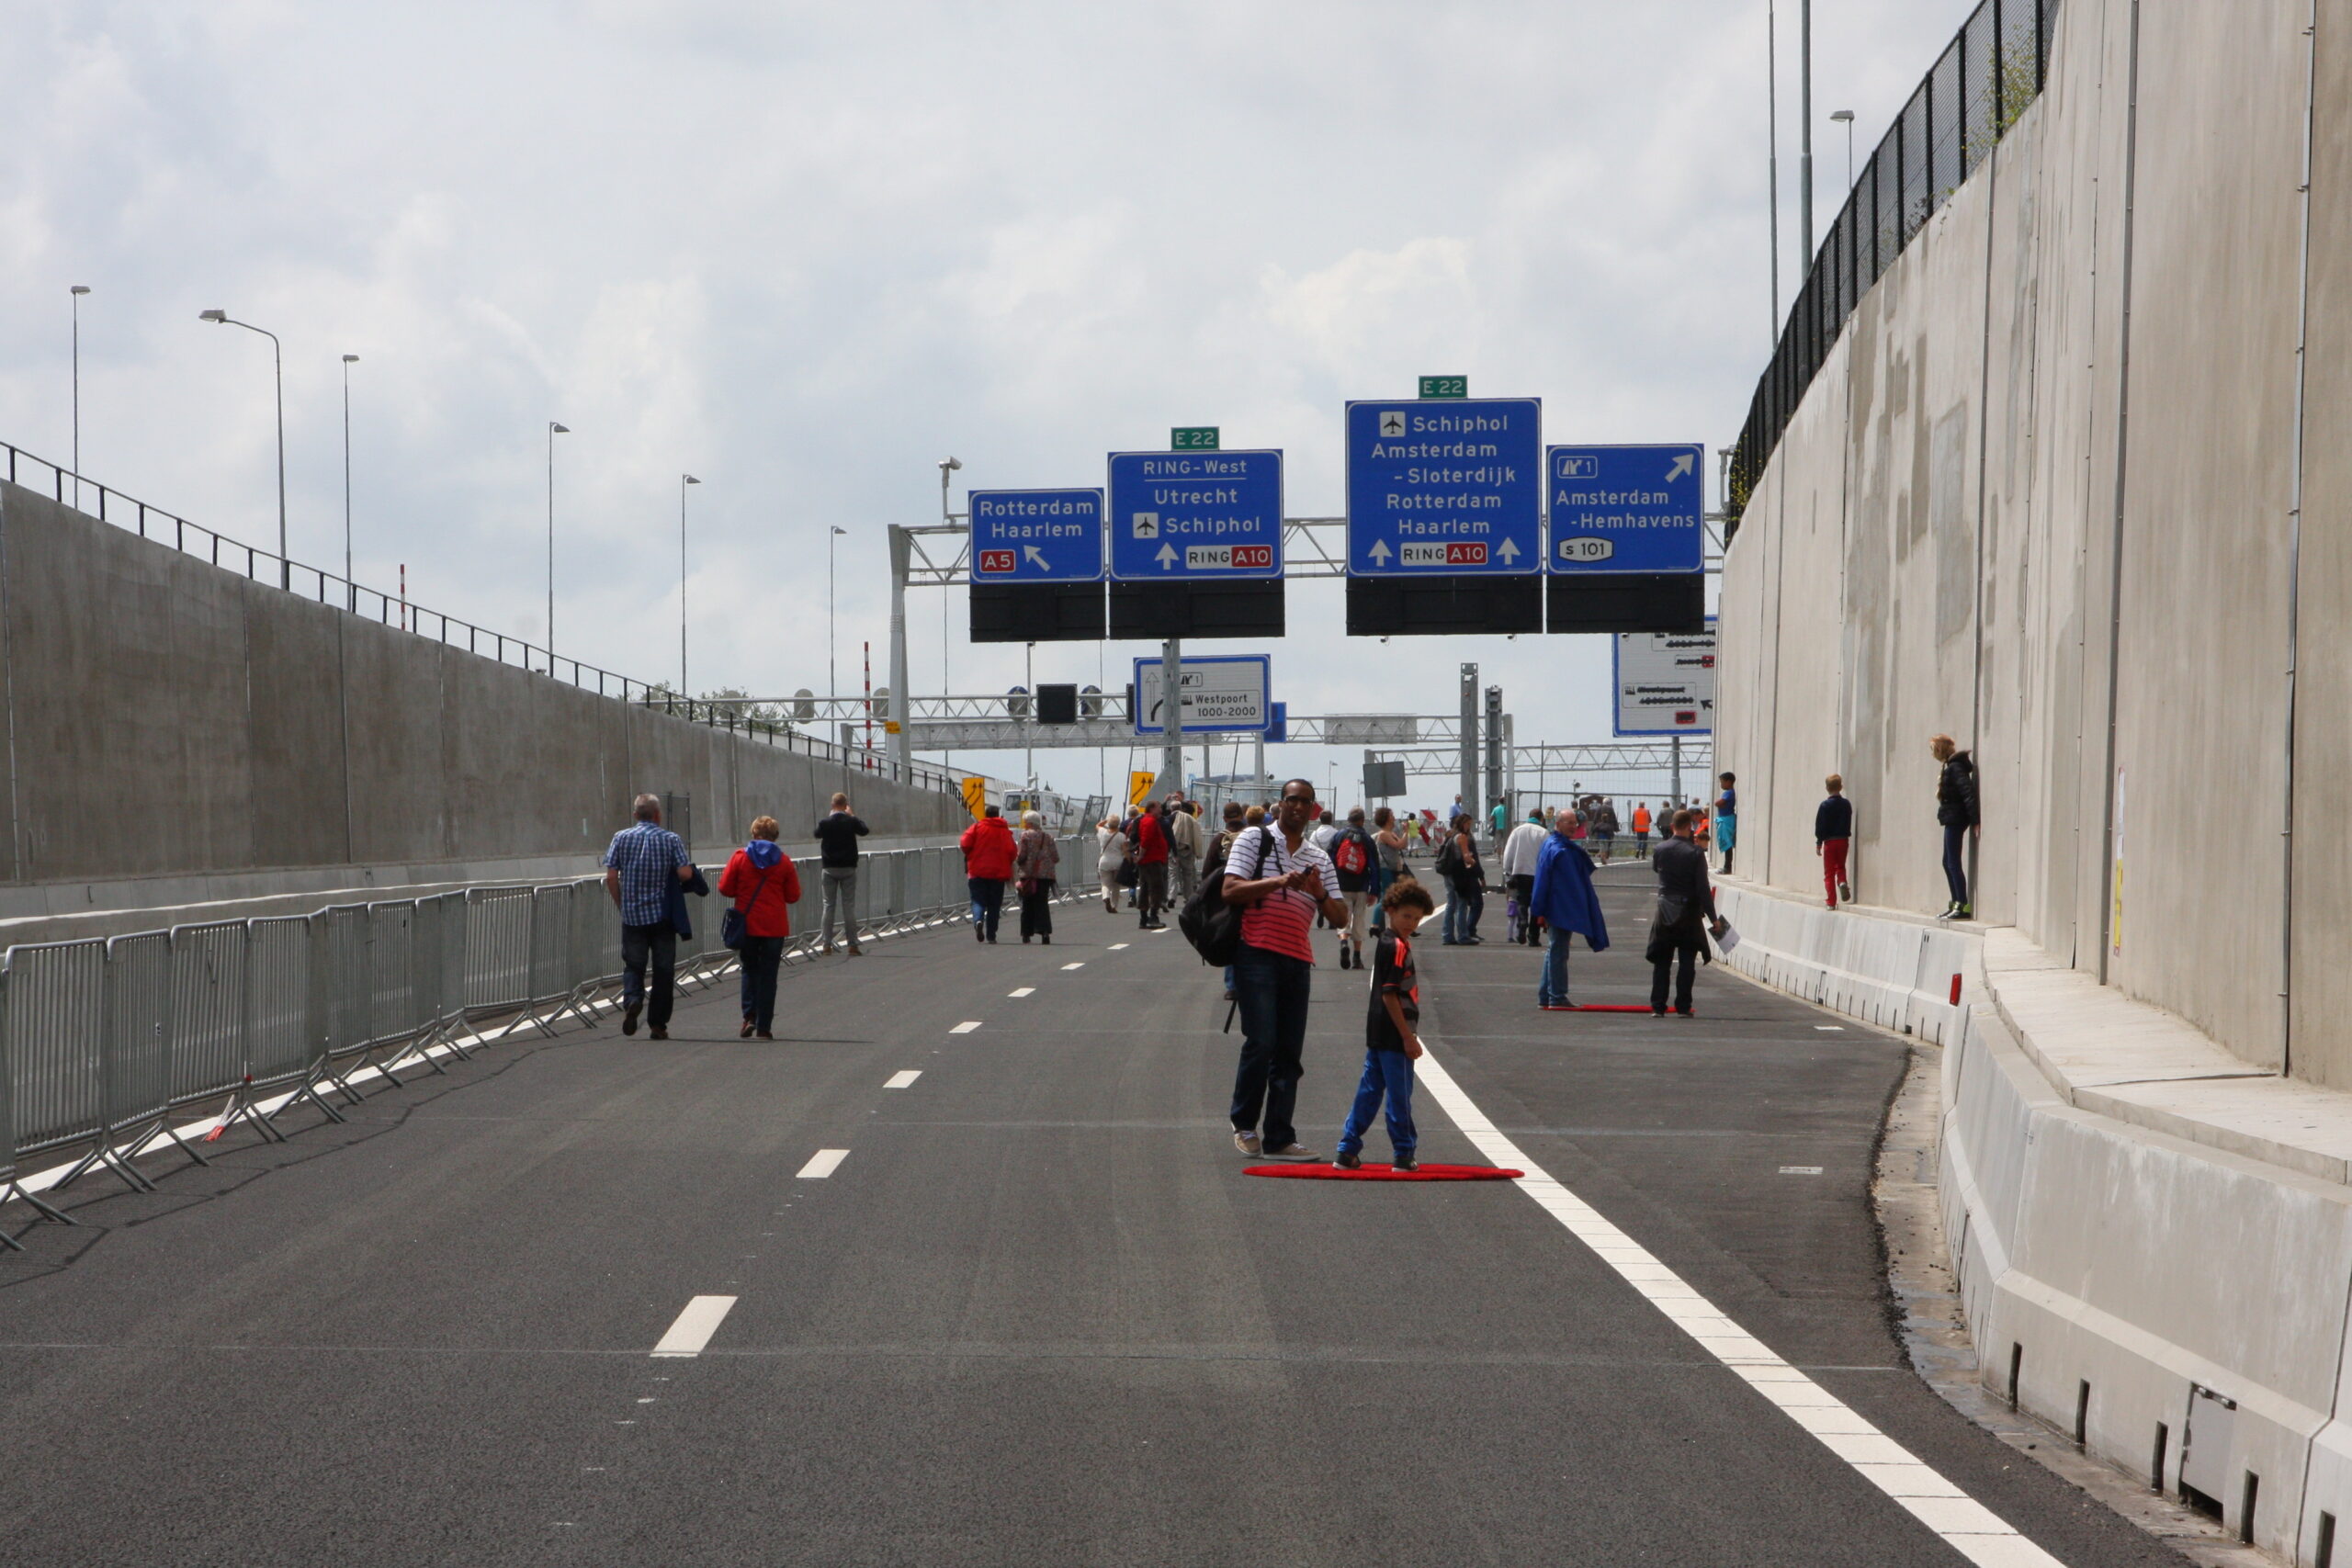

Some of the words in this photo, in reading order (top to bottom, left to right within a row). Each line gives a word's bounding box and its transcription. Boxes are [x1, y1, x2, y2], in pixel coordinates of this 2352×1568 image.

[1423, 381, 1432, 394] E
[1439, 380, 1463, 394] 22
[1413, 414, 1509, 434] Schiphol
[1175, 433, 1186, 446] E
[1192, 432, 1215, 446] 22
[1371, 442, 1498, 459] Amsterdam
[1144, 459, 1248, 475] RING-West
[1586, 461, 1591, 473] 1
[1395, 466, 1516, 487] -Sloterdijk
[1155, 487, 1238, 504] Utrecht
[1386, 492, 1502, 510] Rotterdam
[1555, 489, 1669, 506] Amsterdam
[979, 499, 1094, 516] Rotterdam
[991, 520, 1083, 538] Haarlem
[1165, 516, 1261, 536] Schiphol
[1398, 518, 1491, 535] Haarlem
[1570, 512, 1695, 529] -Hemhavens
[983, 555, 1012, 569] A5
[1188, 550, 1230, 564] RING
[1235, 549, 1269, 563] A10
[1403, 547, 1445, 561] RING
[1450, 547, 1485, 560] A10
[1196, 694, 1248, 704] Westpoort
[1198, 706, 1256, 716] 1000-2000
